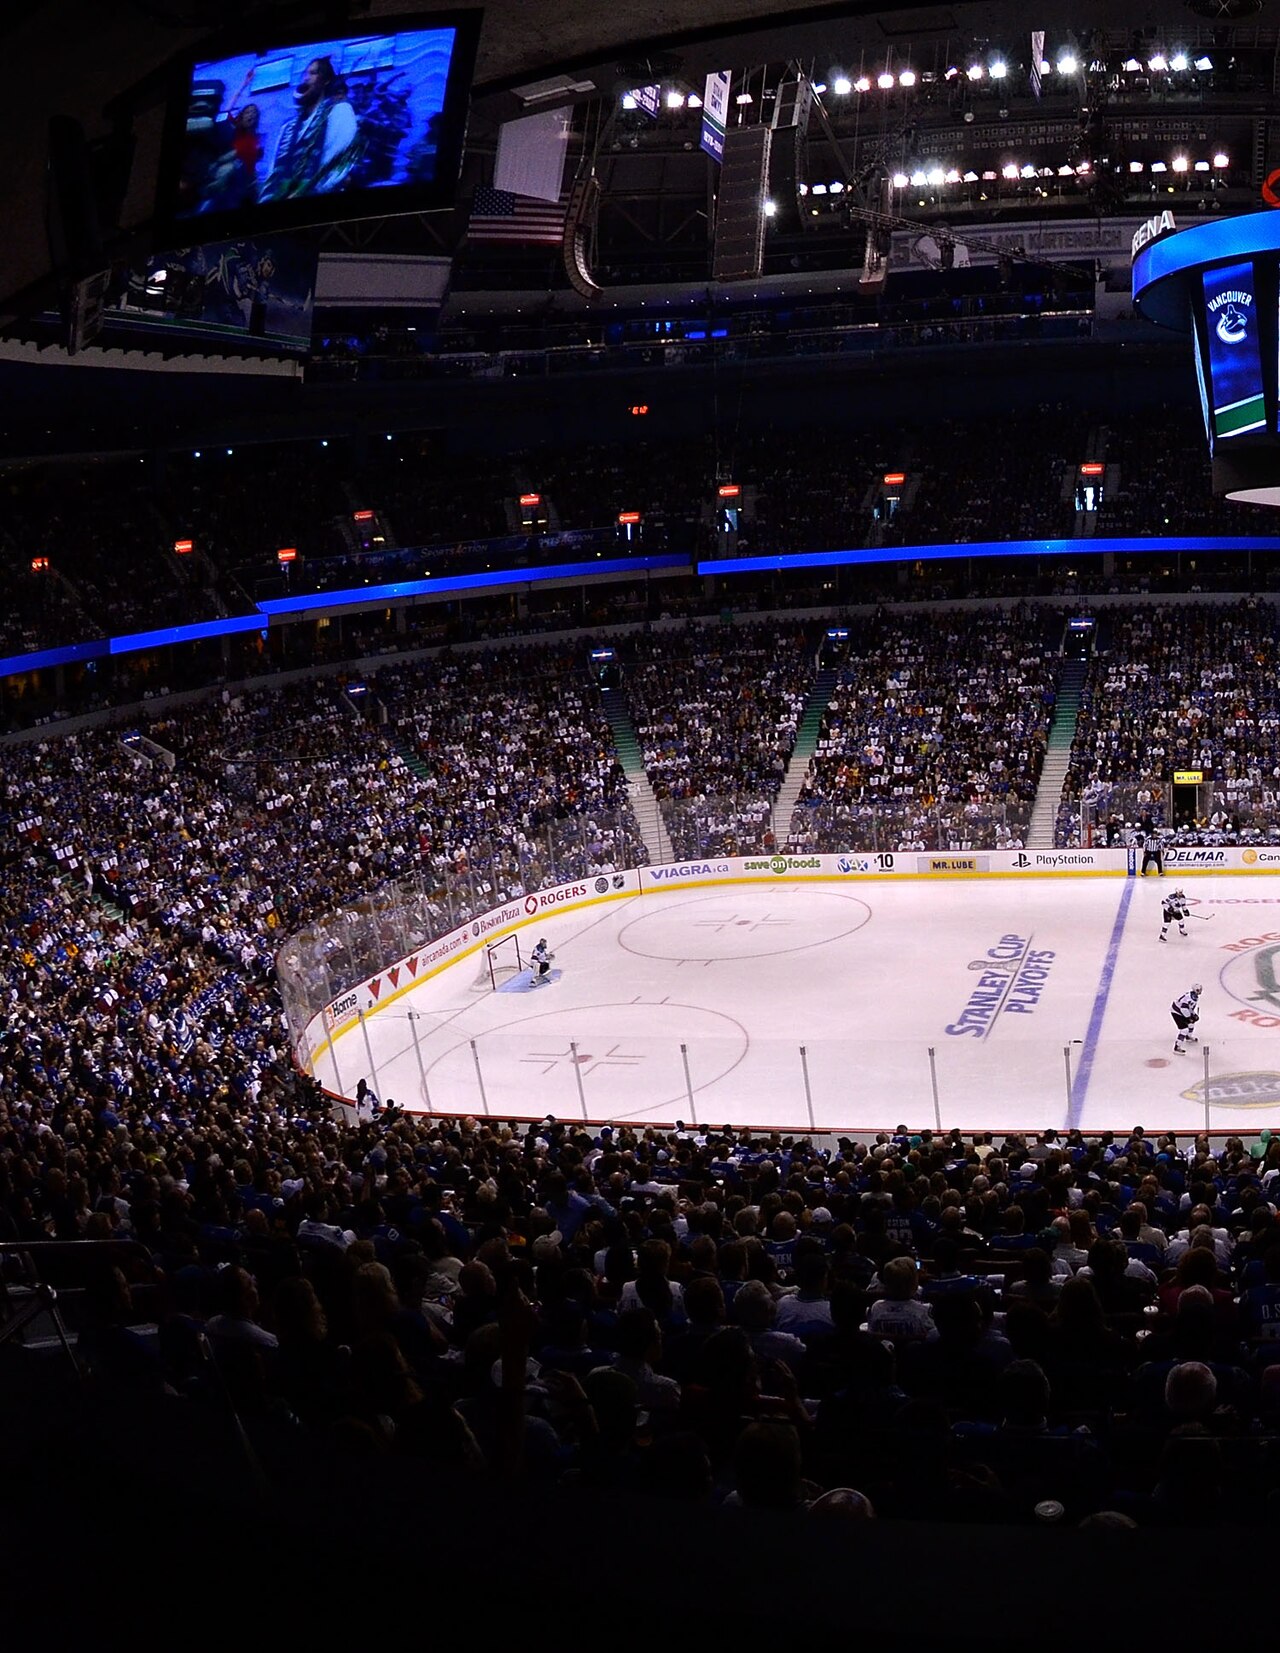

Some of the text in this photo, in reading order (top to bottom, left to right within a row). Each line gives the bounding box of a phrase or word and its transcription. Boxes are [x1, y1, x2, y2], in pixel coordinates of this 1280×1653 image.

[1131, 210, 1177, 250] RENA
[1207, 290, 1252, 312] VANCOUVER
[932, 860, 974, 869] MR. LUBE
[1036, 854, 1094, 867] PlayStation
[1164, 848, 1225, 862] DELMAR
[650, 864, 729, 880] VIAGRA.ca
[539, 884, 587, 906] ROGERS
[422, 937, 462, 967] aircanada.com
[945, 934, 1027, 1038] STANLEY CUP
[1003, 950, 1056, 1014] PLAYOFFS
[332, 992, 357, 1018] Home
